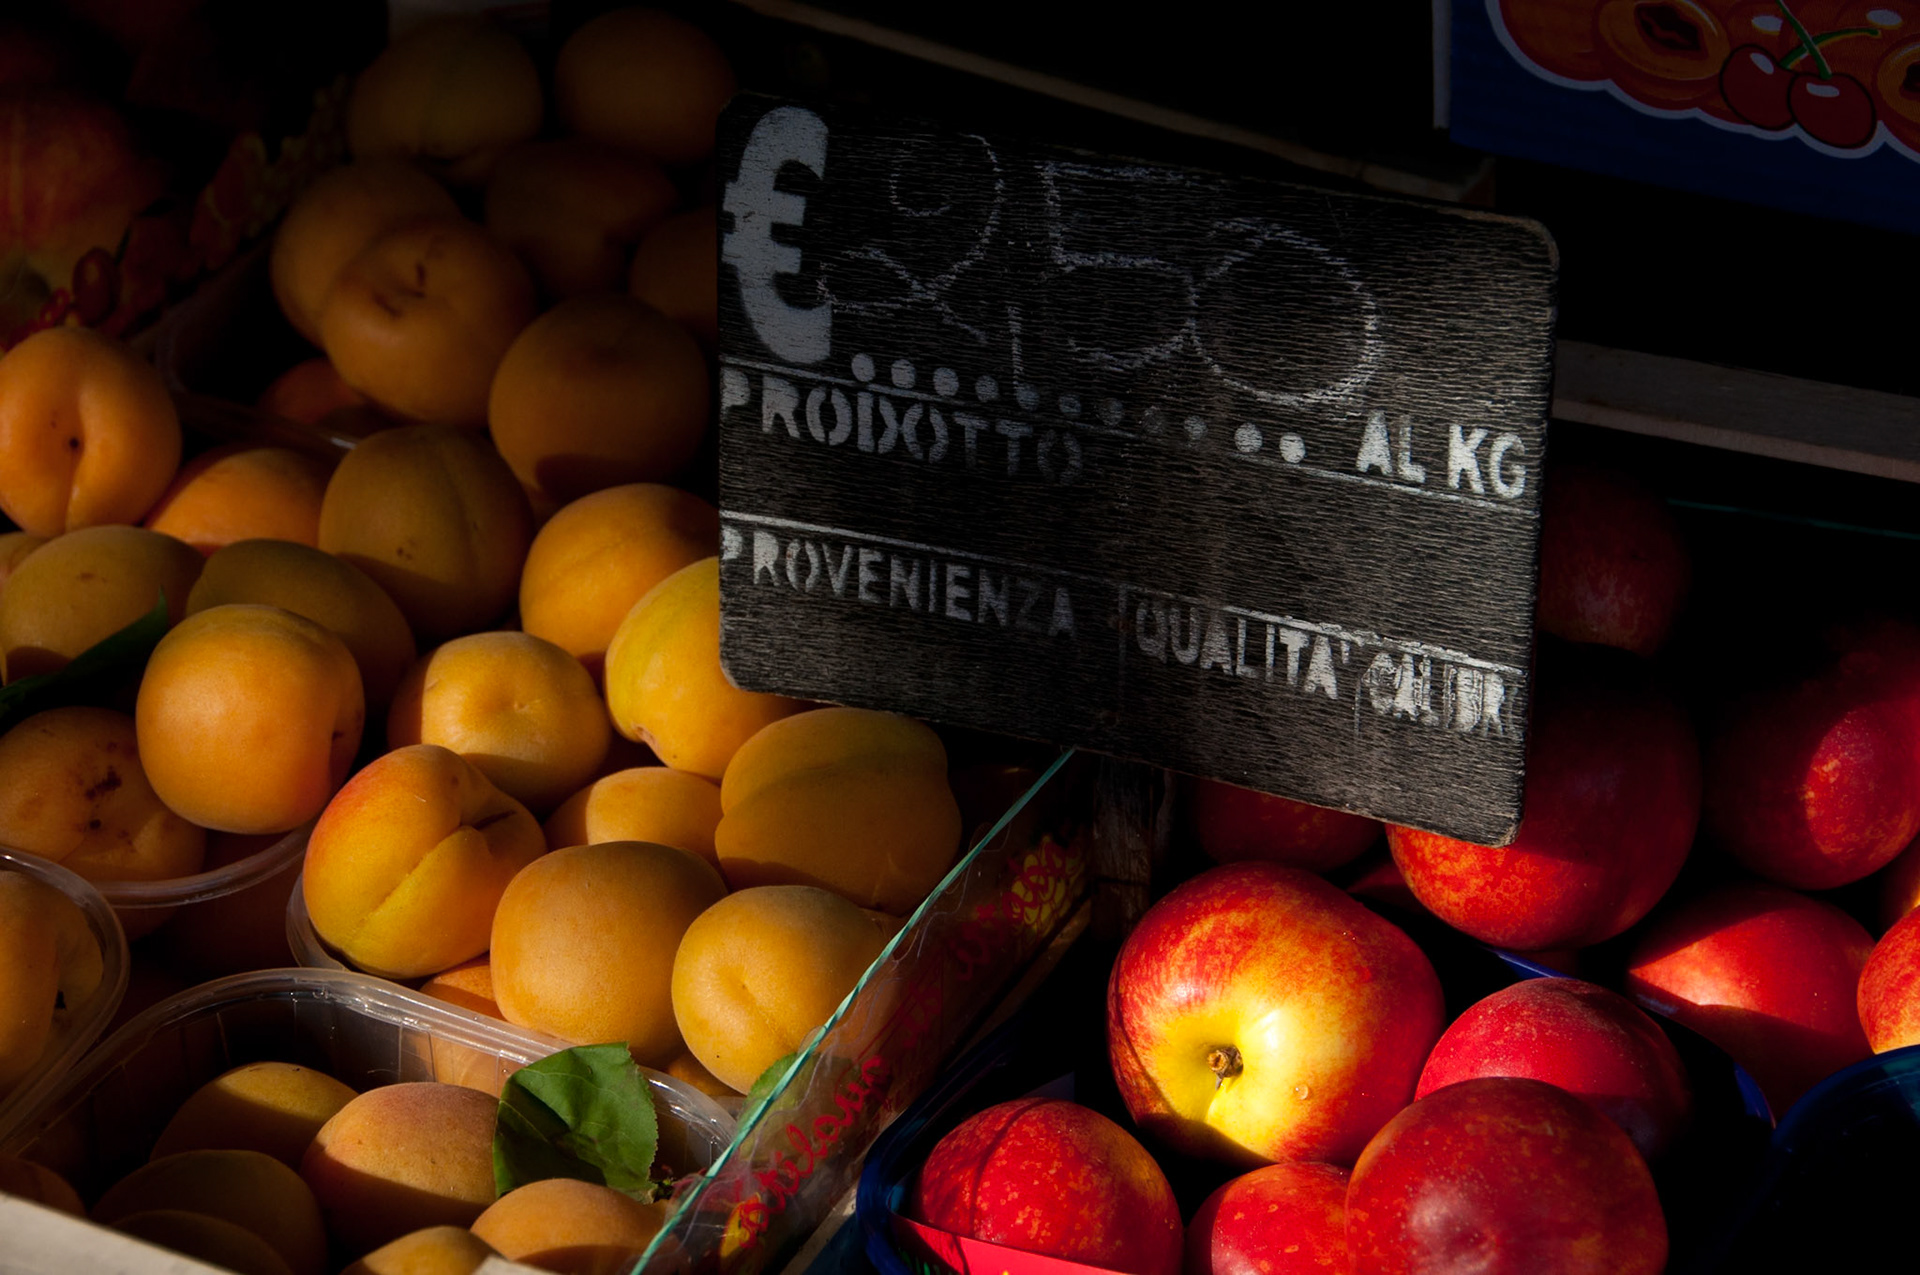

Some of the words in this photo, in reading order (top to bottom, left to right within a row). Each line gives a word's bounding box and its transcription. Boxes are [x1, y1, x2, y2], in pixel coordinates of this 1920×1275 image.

[720, 366, 1084, 487] PRODOTTO
[1355, 409, 1427, 484] AL
[1446, 422, 1528, 499] KG
[721, 524, 1077, 640] PROVENIENZA
[1361, 651, 1519, 736] CALIBR
